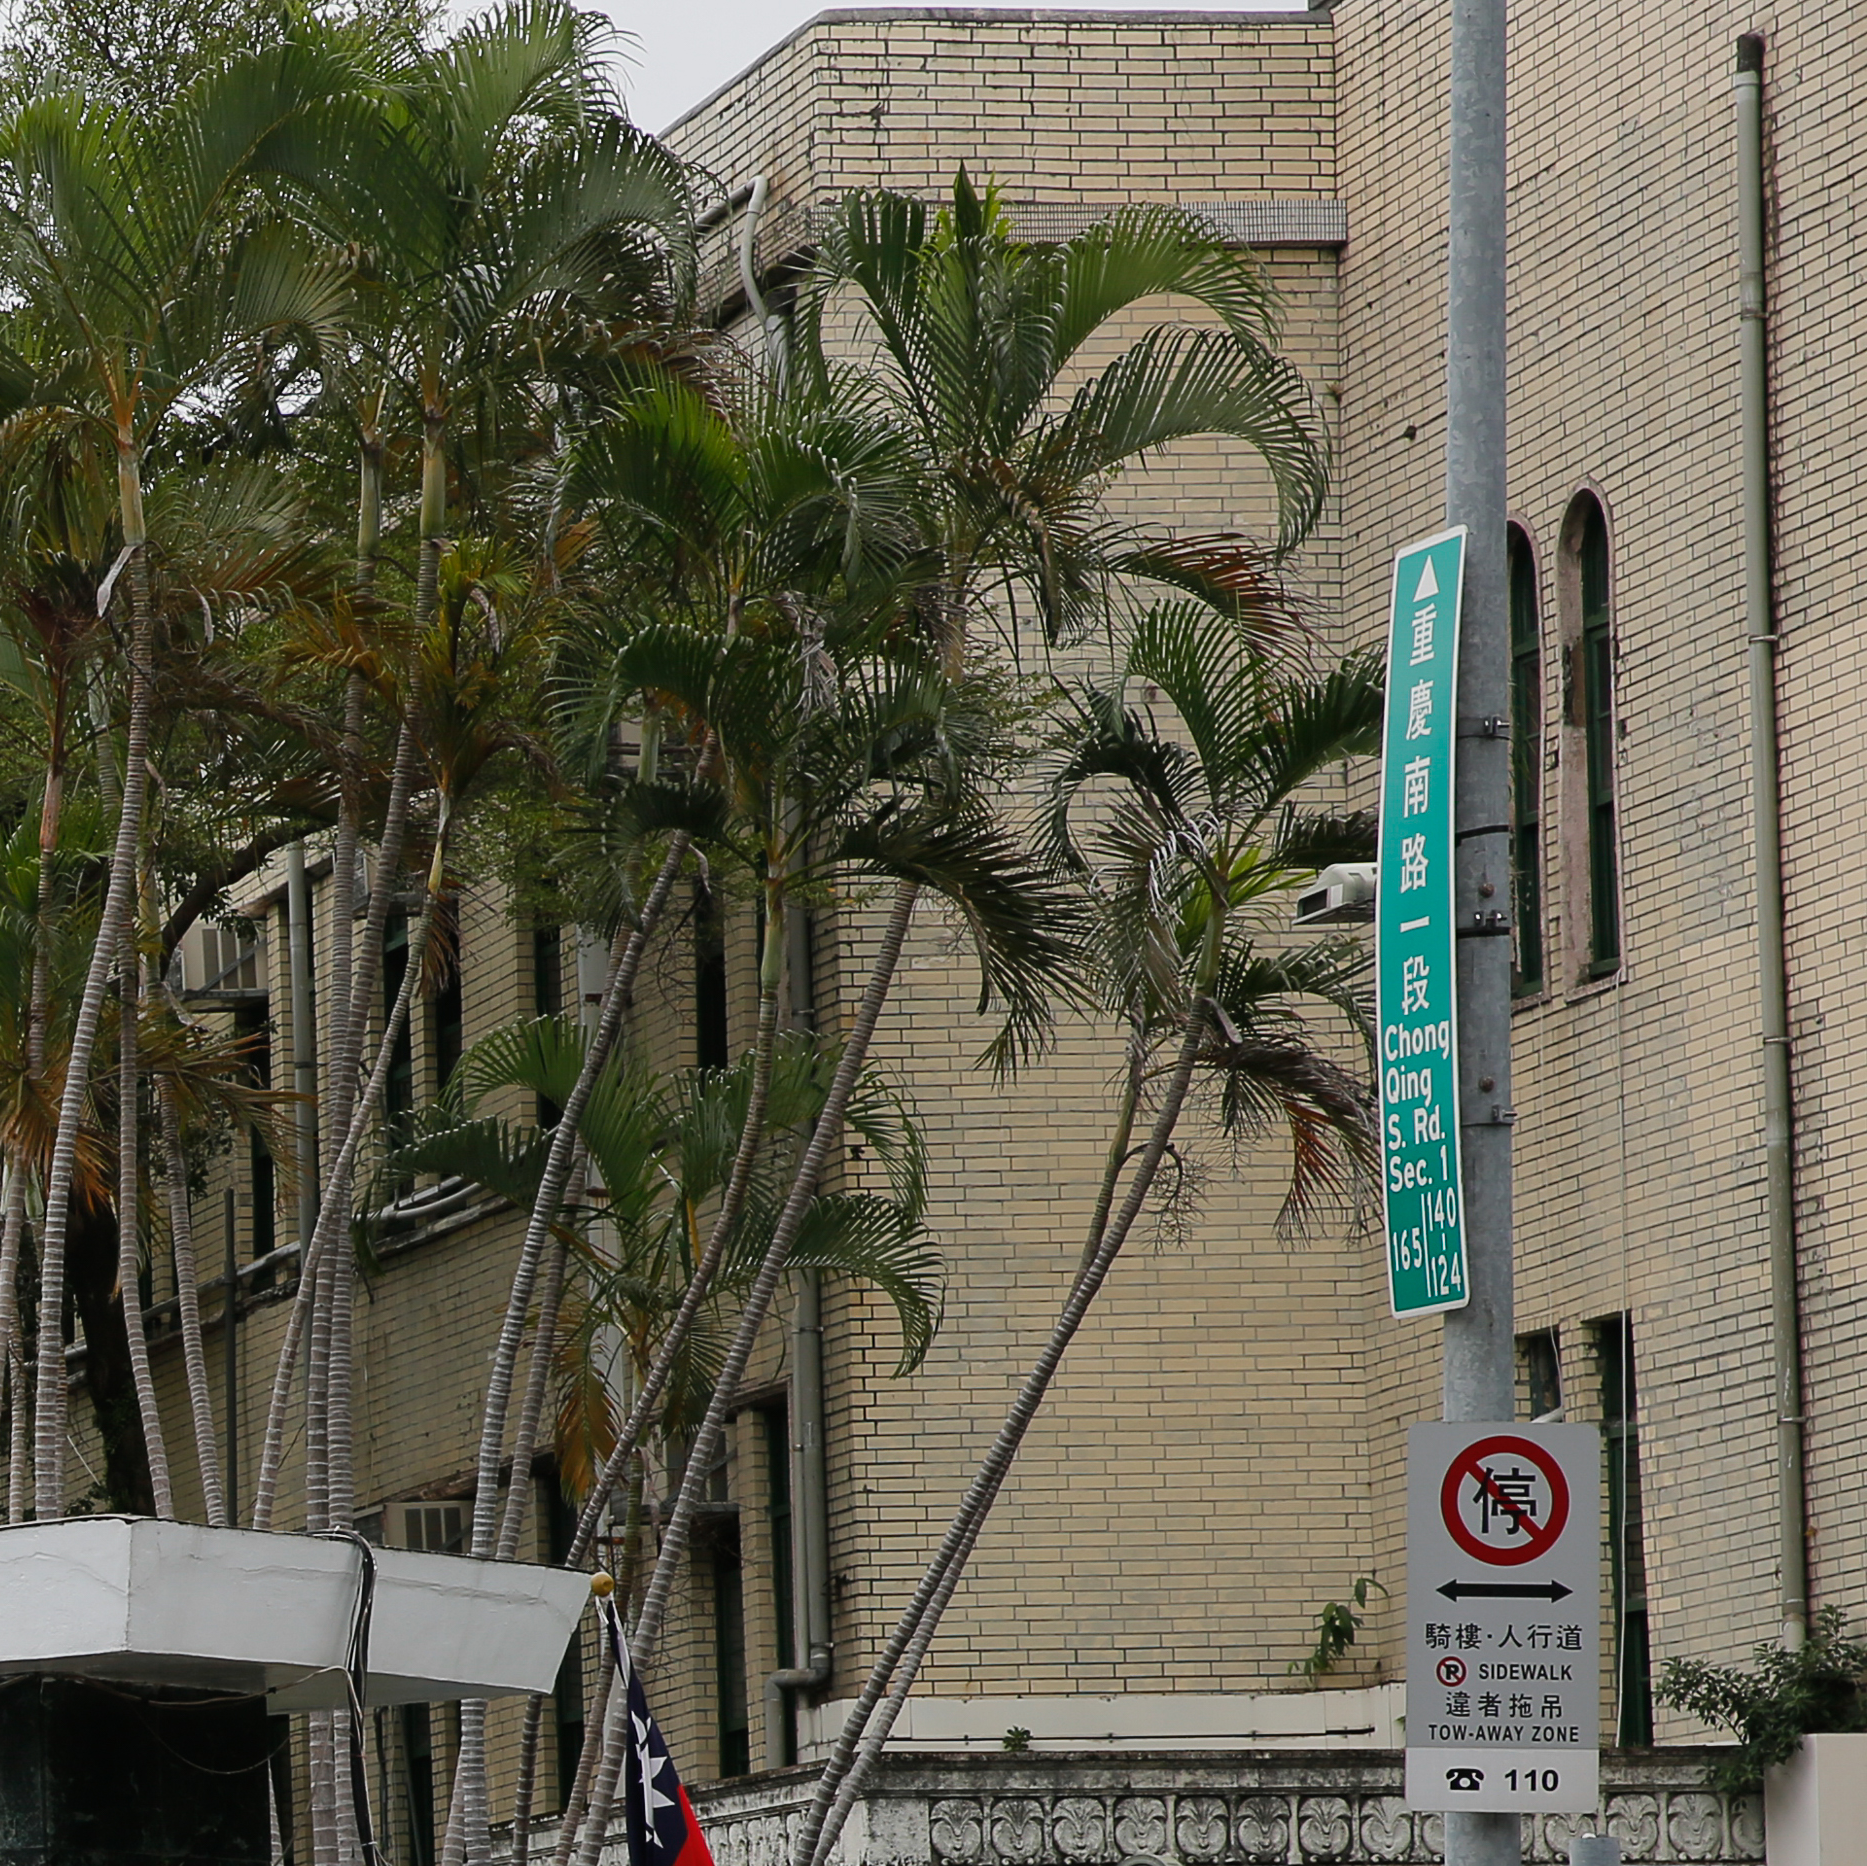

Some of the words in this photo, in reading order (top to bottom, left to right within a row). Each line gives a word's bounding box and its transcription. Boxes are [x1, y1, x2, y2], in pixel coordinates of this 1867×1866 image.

[1399, 602, 1438, 1017] 重慶南路一段
[1384, 1019, 1450, 1062] Chong
[1385, 1065, 1432, 1107] Qing
[1387, 1113, 1407, 1151] S.
[1413, 1104, 1446, 1145] Rd.
[1389, 1155, 1433, 1193] Sec.
[1439, 1144, 1448, 1181] 1
[1427, 1187, 1457, 1232] 140
[1392, 1227, 1423, 1272] 165
[1431, 1252, 1462, 1297] 124
[1472, 1466, 1538, 1536] 停
[1478, 1663, 1573, 1681] SIDEWALK
[1445, 1690, 1563, 1720] 違者拖吊
[1428, 1724, 1524, 1741] TOW-AWAY
[1531, 1725, 1580, 1743] ZONE
[1504, 1768, 1560, 1792] 110
